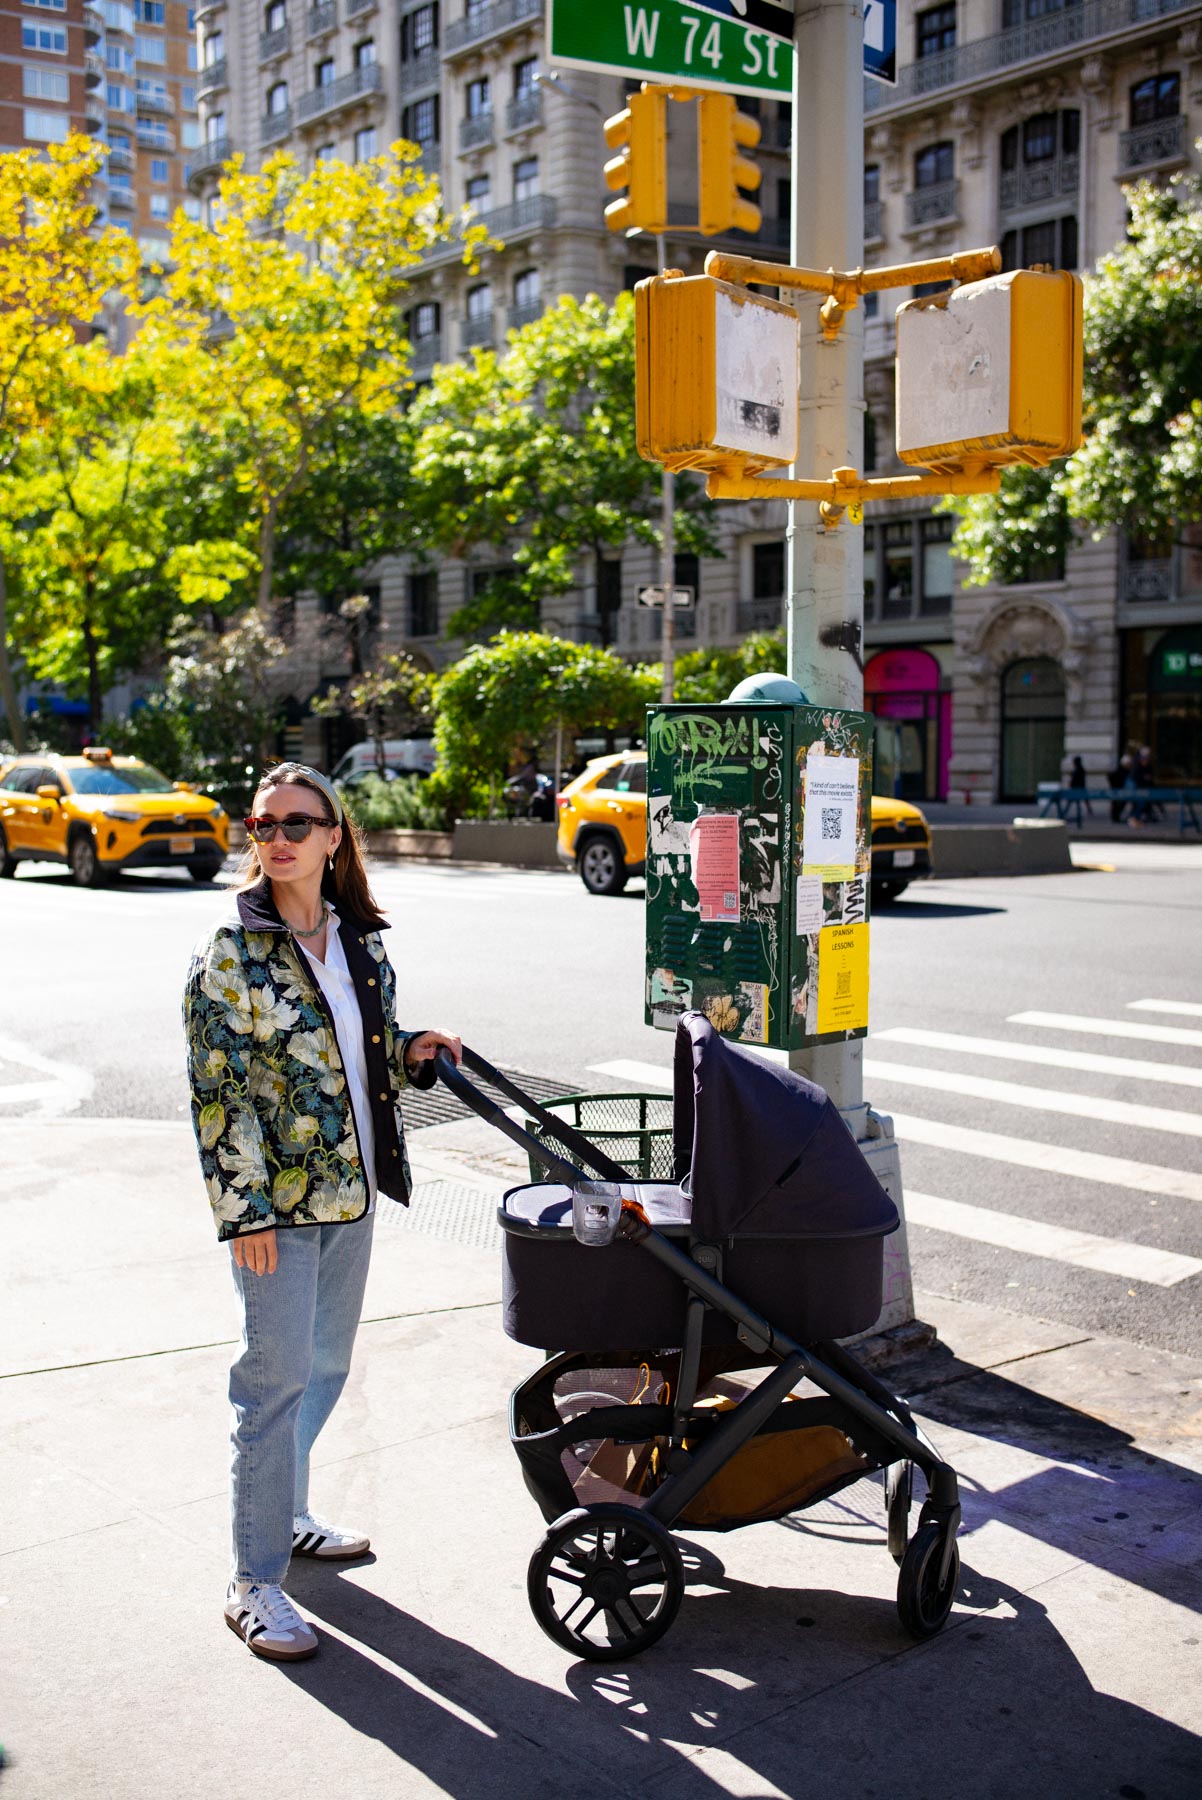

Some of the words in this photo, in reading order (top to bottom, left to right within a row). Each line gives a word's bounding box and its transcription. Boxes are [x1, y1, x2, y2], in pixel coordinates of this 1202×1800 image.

[624, 5, 660, 58] W
[681, 16, 723, 69] 74
[742, 28, 780, 78] St
[831, 928, 854, 937] SPANISH
[831, 940, 855, 951] LESSONS
